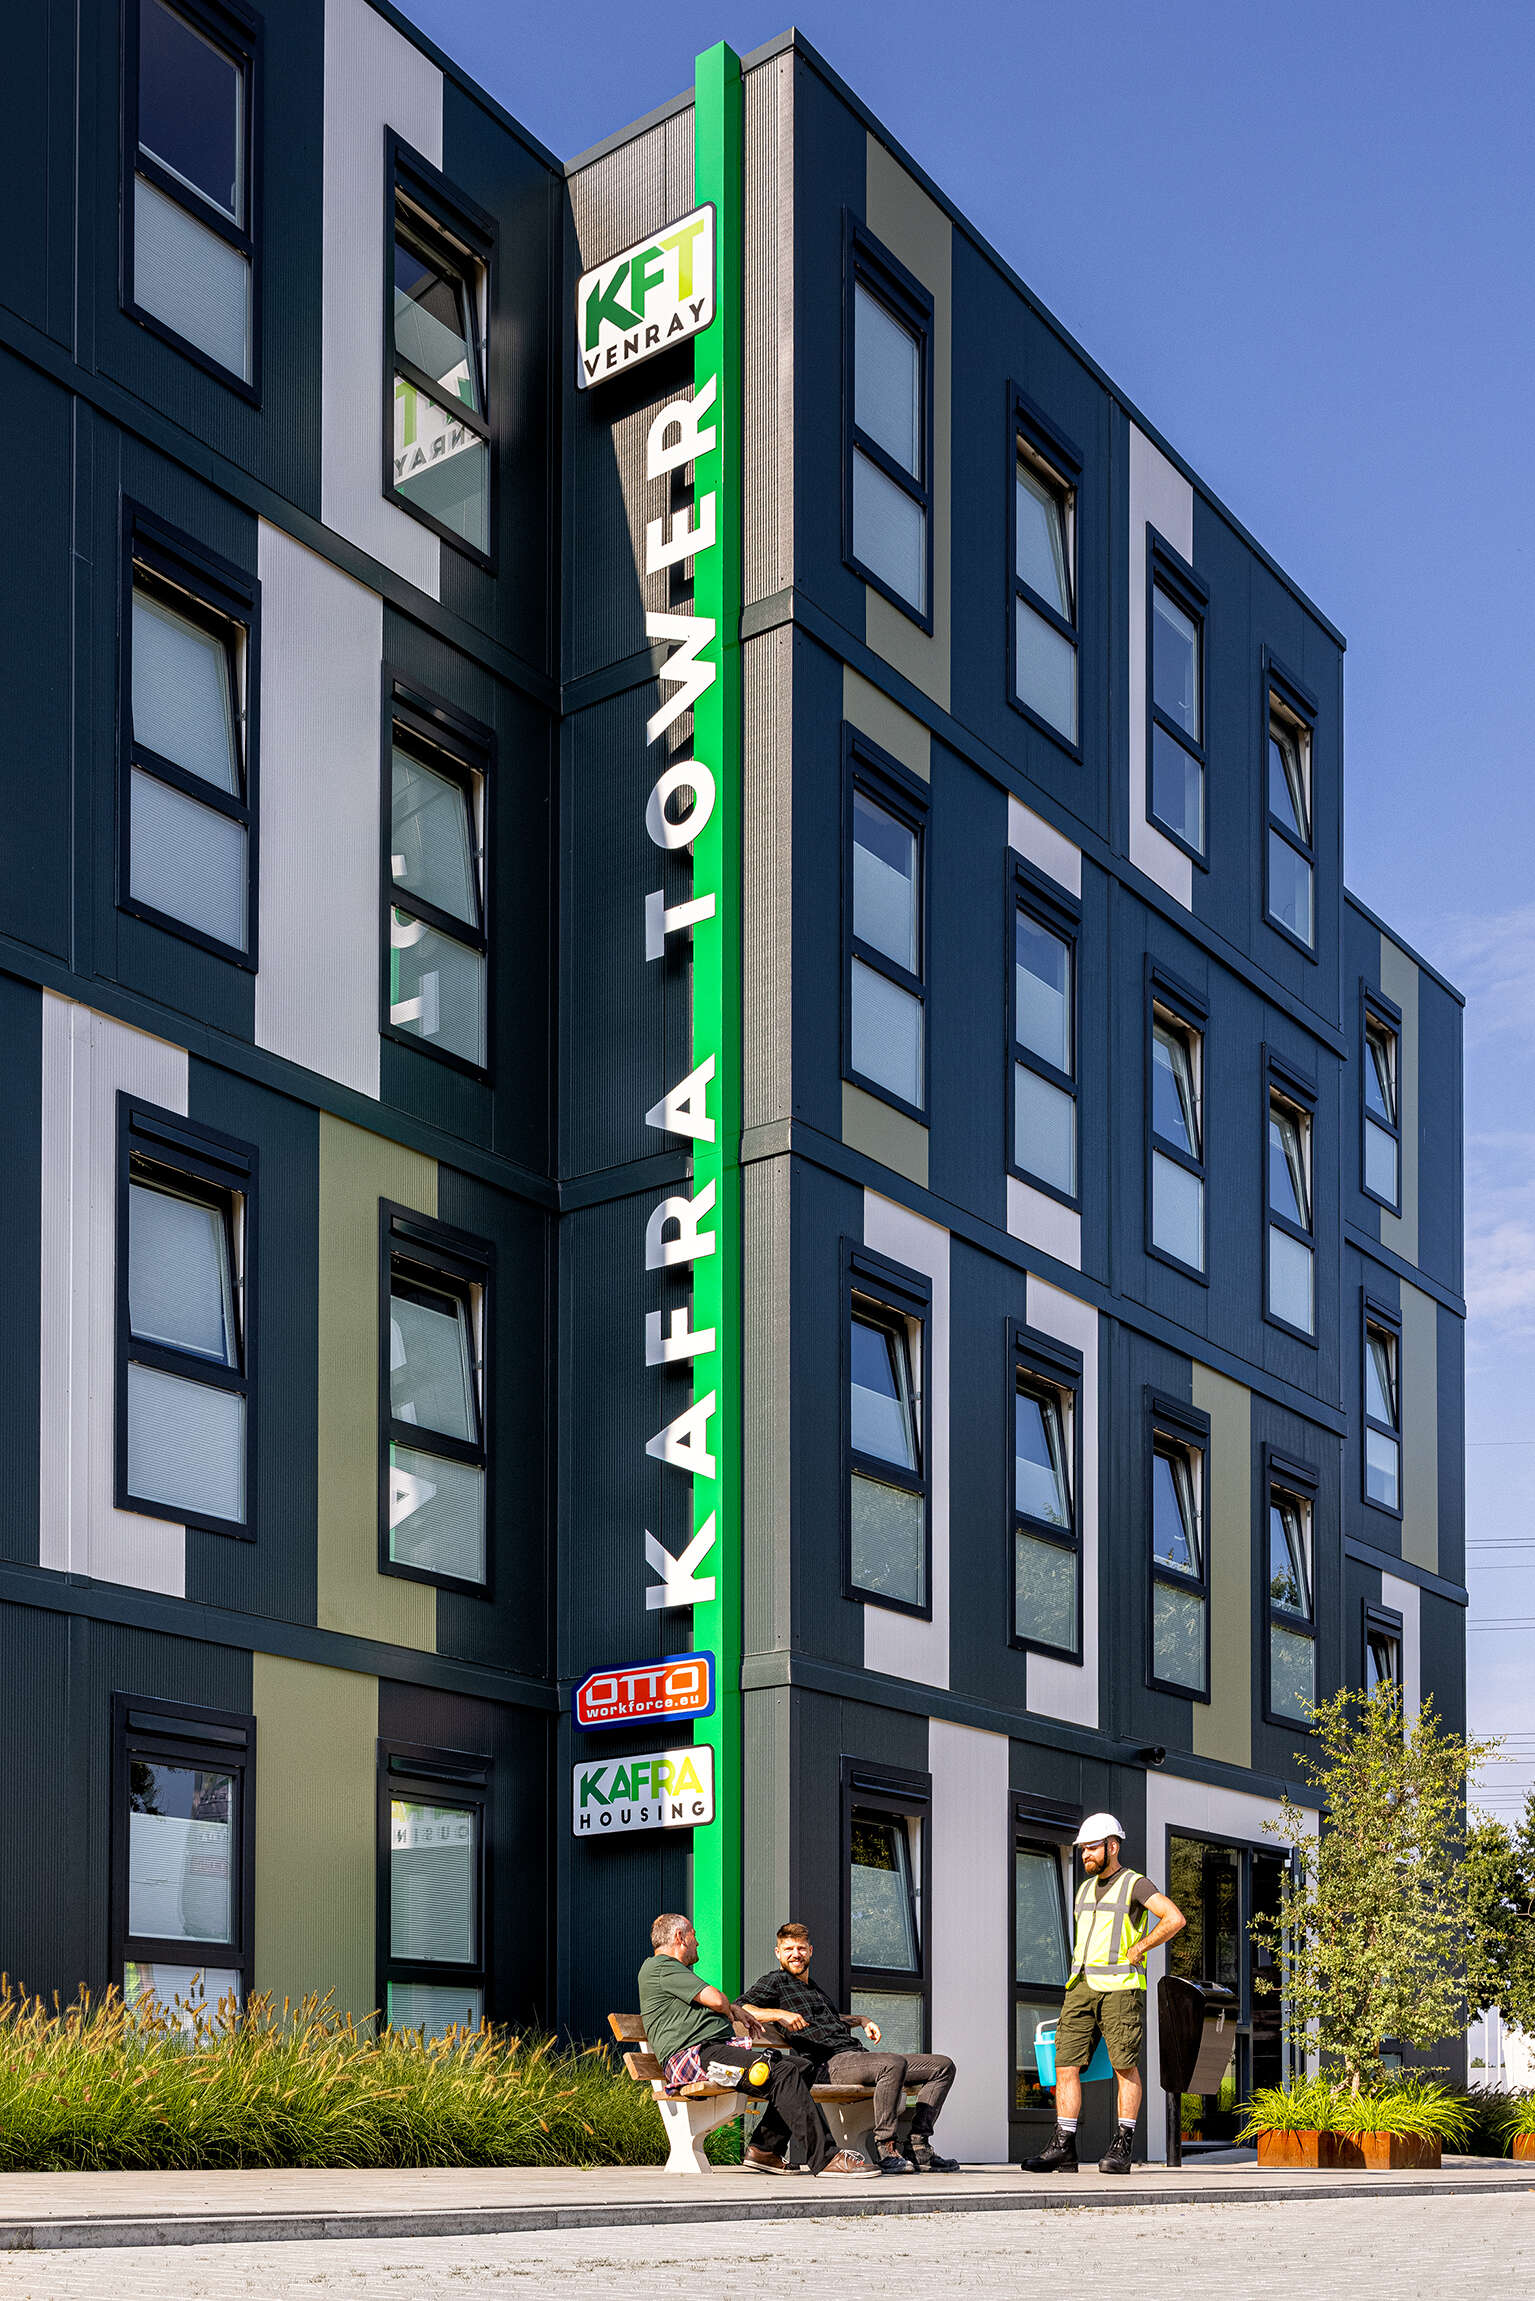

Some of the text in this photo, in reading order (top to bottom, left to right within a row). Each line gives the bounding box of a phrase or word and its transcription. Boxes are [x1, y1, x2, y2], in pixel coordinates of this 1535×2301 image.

[586, 219, 704, 352] KFT
[584, 298, 705, 377] VENRAY
[645, 373, 717, 1610] KAFRA TOWER
[585, 1666, 699, 1706] OTTO
[586, 1694, 699, 1718] workforce.eu
[580, 1756, 704, 1808] KAFRA
[580, 1801, 704, 1829] HOUSING
